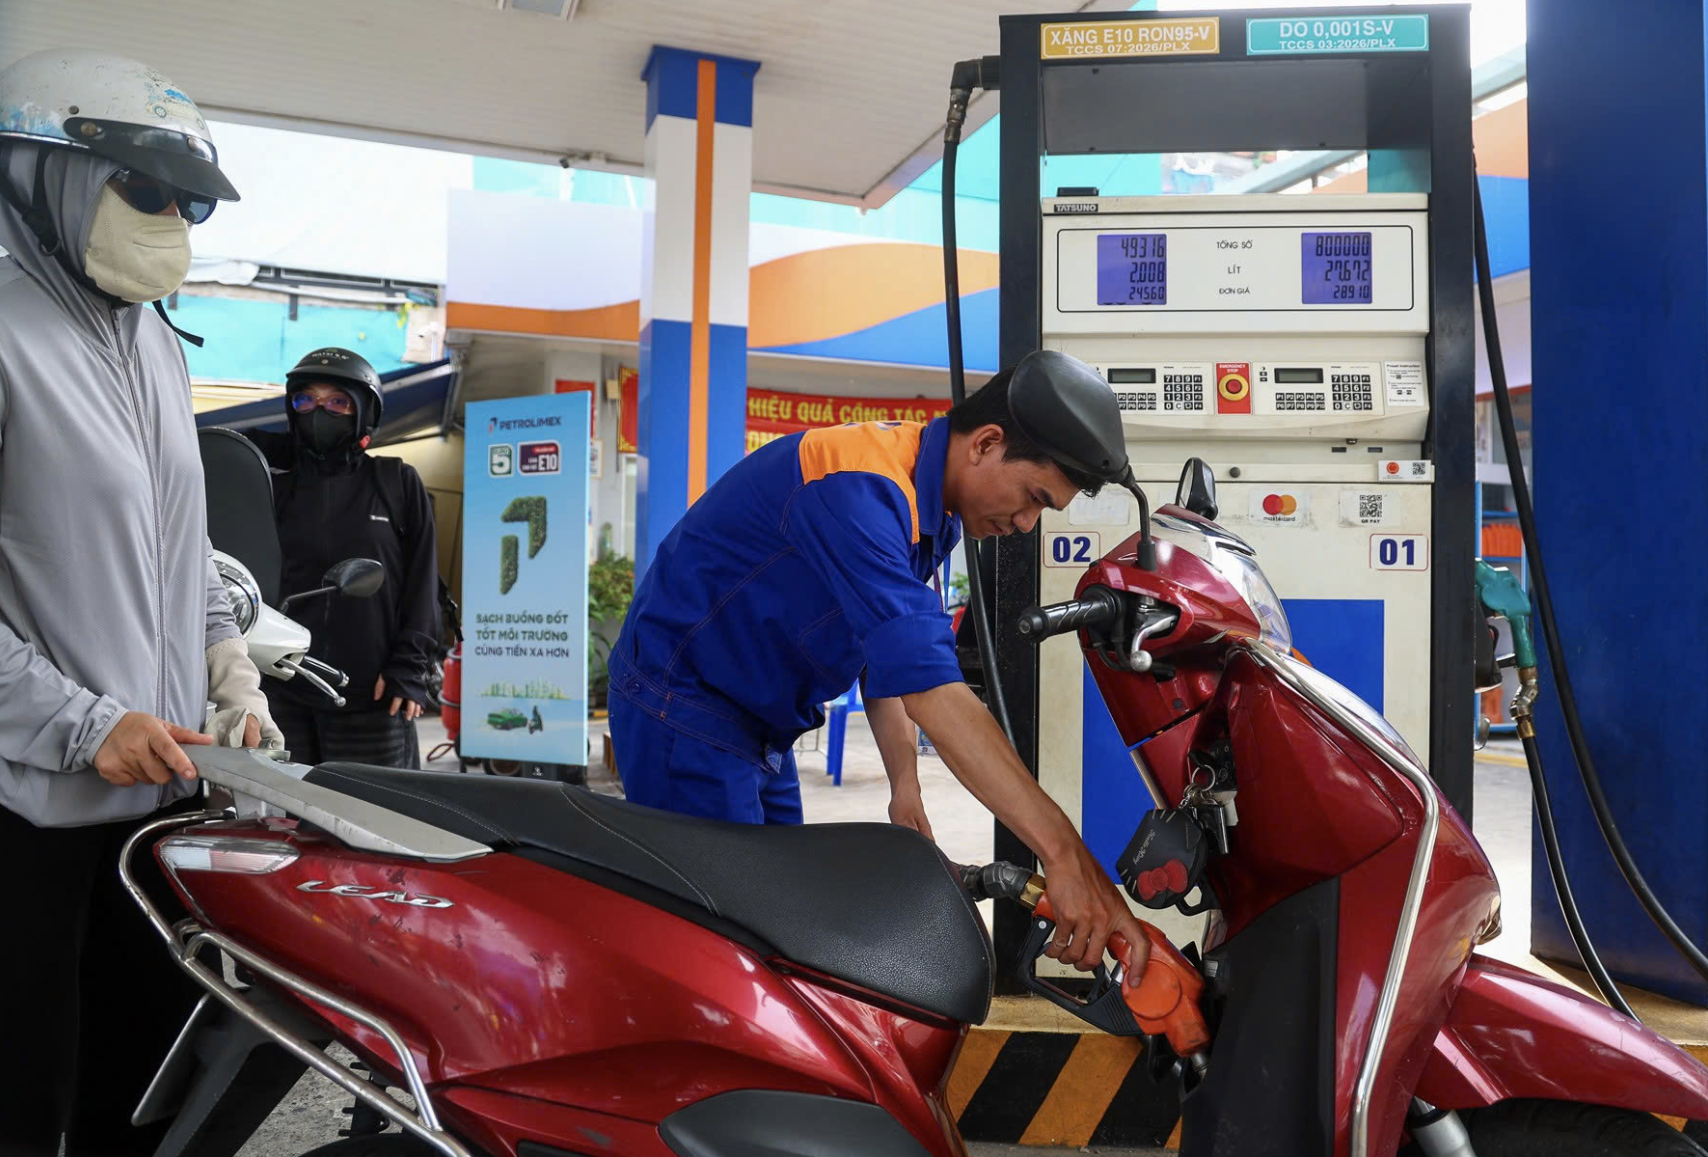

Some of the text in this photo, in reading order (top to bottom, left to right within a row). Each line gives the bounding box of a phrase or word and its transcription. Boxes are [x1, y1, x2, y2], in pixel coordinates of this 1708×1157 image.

[1050, 26, 1210, 45] XĂNG E10 RON95-V
[1280, 20, 1394, 38] DO 0,001S-V
[1066, 42, 1190, 55] TCCS 07:2026/PLX
[1279, 38, 1396, 50] TCCS 03:2026/PLX
[1056, 204, 1097, 212] TATSUNO
[1121, 237, 1165, 258] 49316
[1242, 239, 1254, 249] SỐ
[1316, 235, 1370, 256] 800000
[1228, 264, 1241, 274] LÍT
[1129, 286, 1165, 300] 24560
[1237, 286, 1250, 294] GIÁ
[1334, 285, 1370, 299] 28910
[748, 395, 792, 423] HIỆU
[499, 416, 561, 430] PETROLIMEX
[492, 454, 510, 474] 5
[538, 454, 557, 470] E10
[1053, 536, 1091, 563] 02
[1380, 538, 1414, 565] 01
[530, 648, 543, 657] XA
[546, 647, 569, 657] HƠN
[296, 880, 455, 908] LEAD
